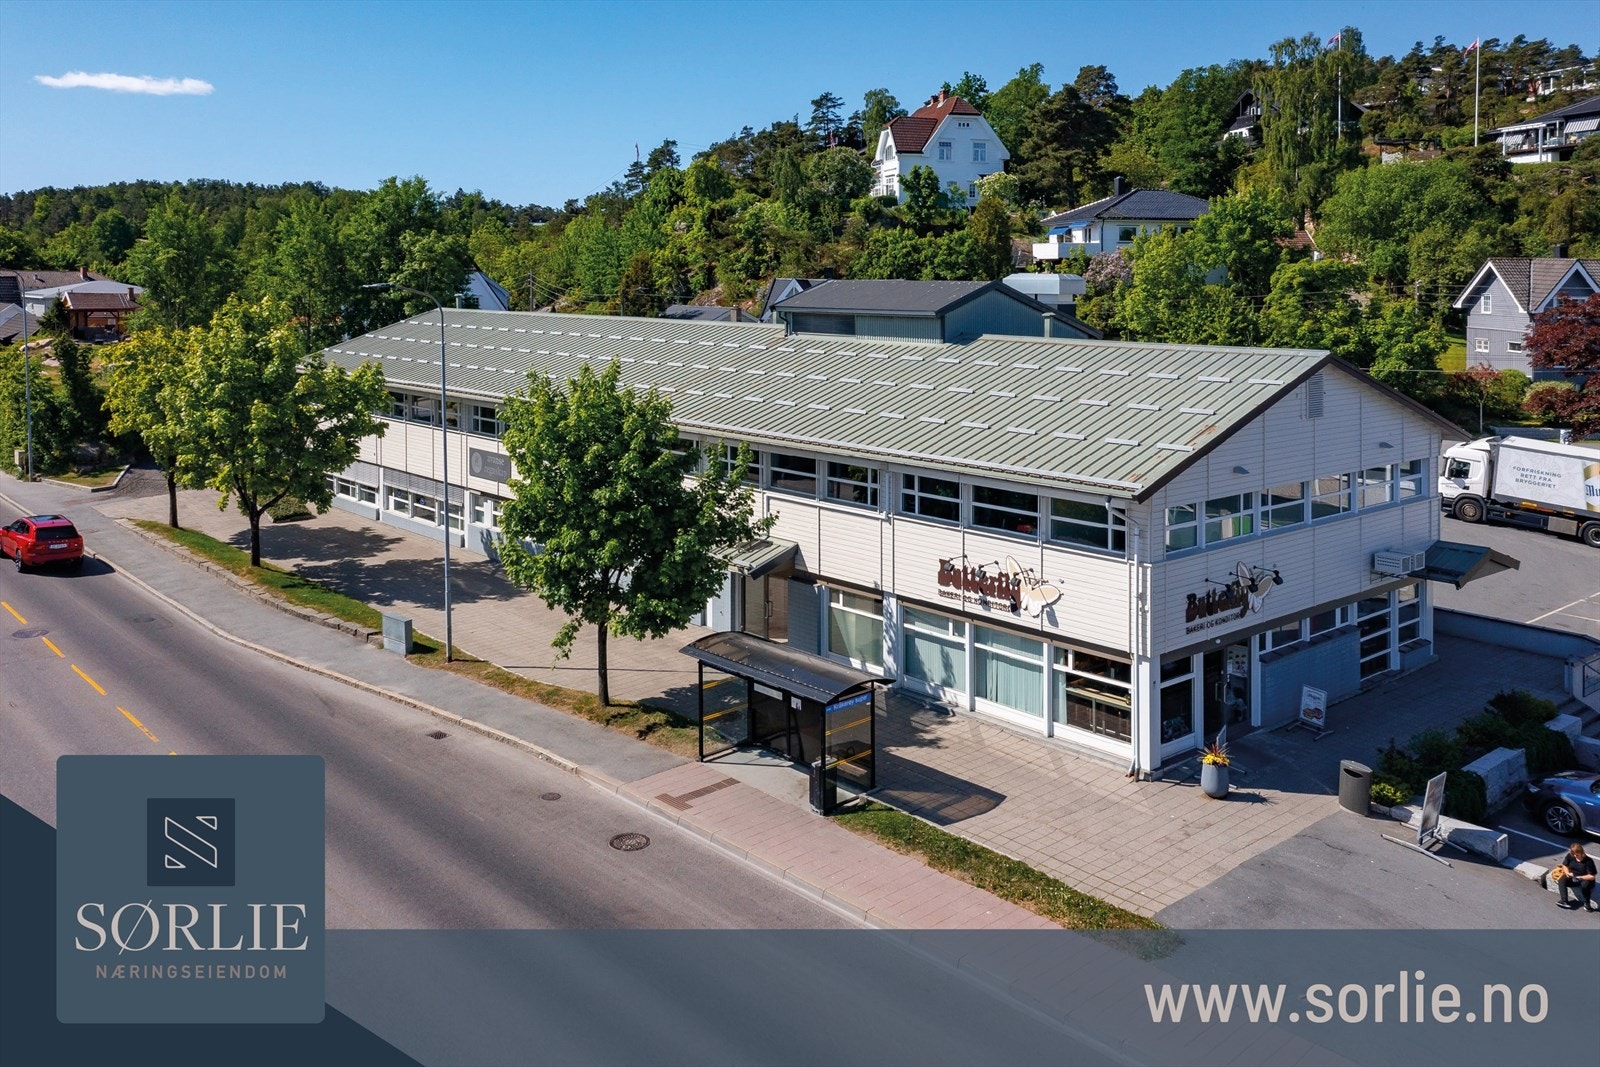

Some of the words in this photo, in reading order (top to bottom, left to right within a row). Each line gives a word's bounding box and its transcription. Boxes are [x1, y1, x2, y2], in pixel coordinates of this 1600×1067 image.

[1513, 465, 1562, 478] FORFRISKNING
[1515, 478, 1556, 489] BRYGGERIET
[1186, 622, 1205, 635] BAKERI
[1206, 619, 1215, 629] OG
